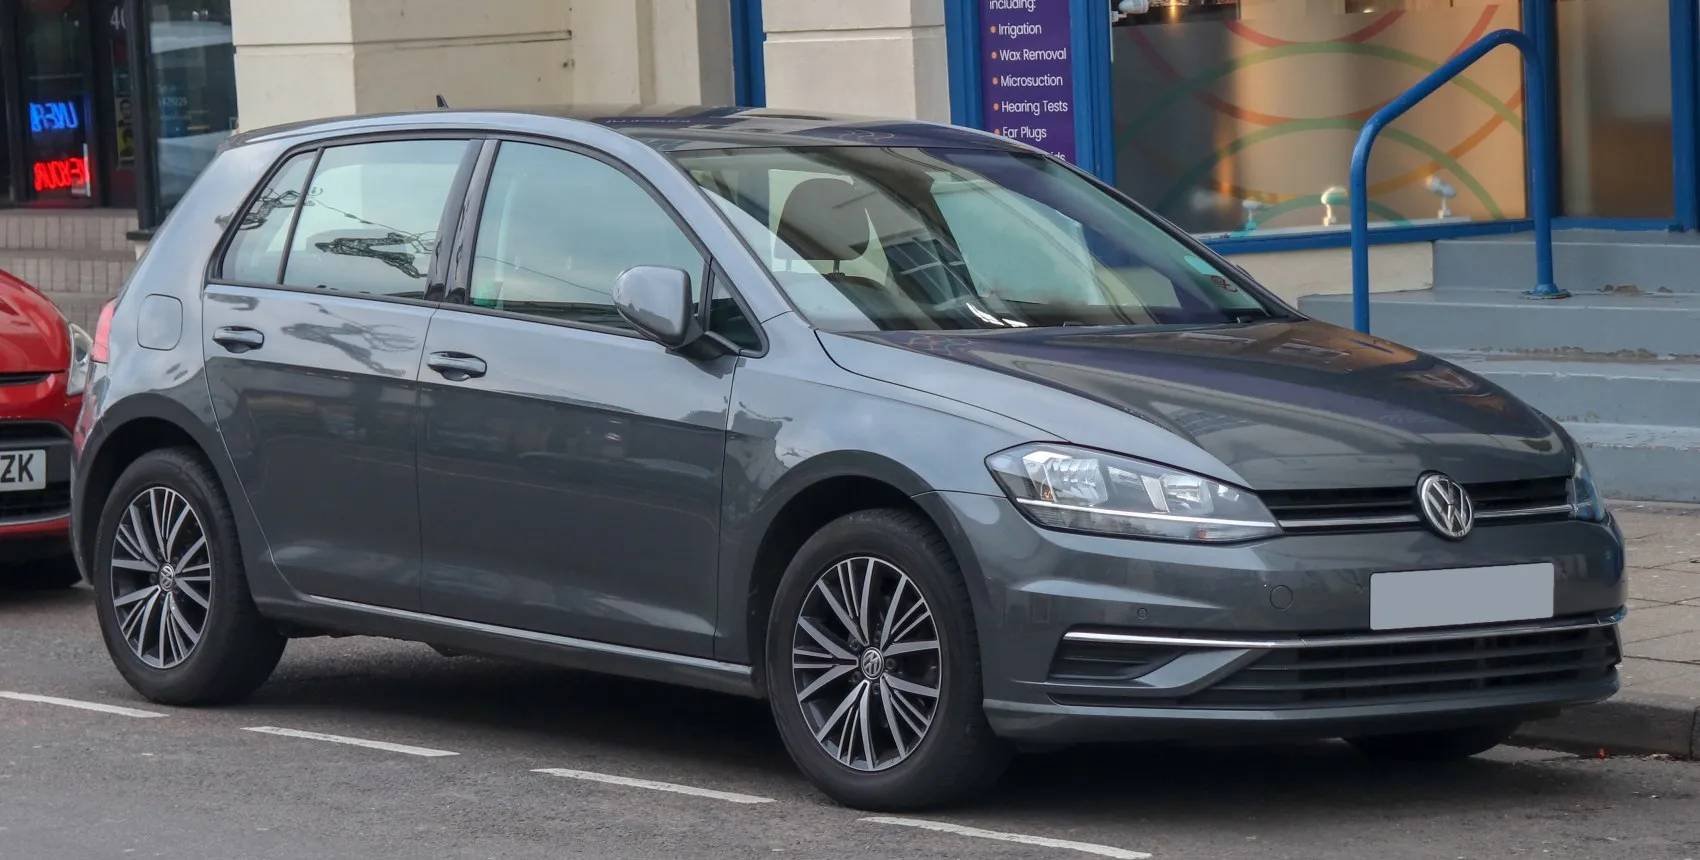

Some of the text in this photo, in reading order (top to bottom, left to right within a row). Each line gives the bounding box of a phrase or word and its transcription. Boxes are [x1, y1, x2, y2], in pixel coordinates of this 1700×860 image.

[989, 0, 1036, 13] including:
[998, 22, 1042, 39] Irrigation
[999, 47, 1067, 61] Wax Removal
[1000, 74, 1063, 87] Microsuction
[1001, 100, 1068, 116] Hearing Tests
[1002, 125, 1047, 142] Ear Plugs
[0, 453, 34, 483] ZK
[1421, 475, 1472, 536] VW
